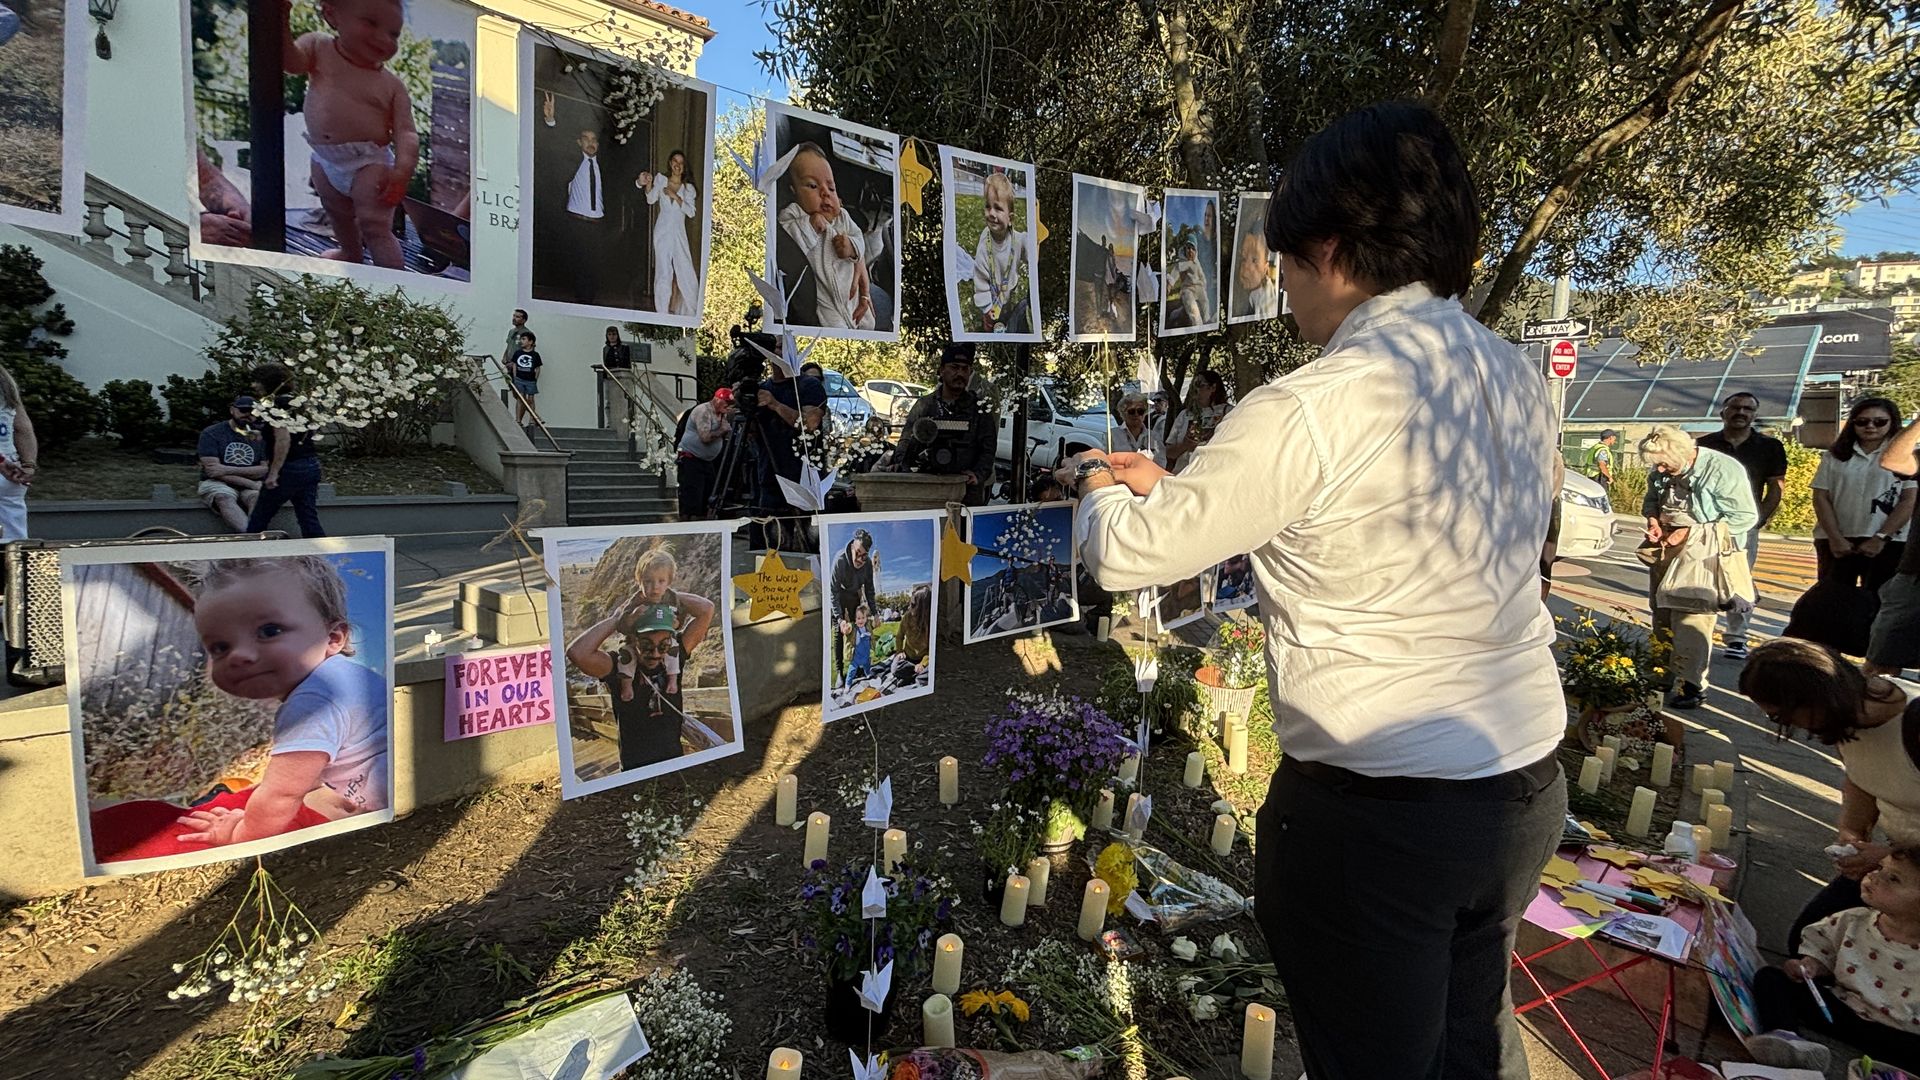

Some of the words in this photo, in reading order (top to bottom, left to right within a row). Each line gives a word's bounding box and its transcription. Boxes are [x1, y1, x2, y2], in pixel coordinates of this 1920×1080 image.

[477, 191, 514, 208] LIC
[1527, 326, 1548, 335] ONE
[1551, 325, 1569, 333] WAY
[1820, 334, 1859, 344] .com
[757, 572, 772, 582] The
[757, 594, 789, 603] without
[768, 603, 788, 612] you
[454, 650, 552, 688] FOREVER
[465, 689, 489, 709] IN
[502, 680, 543, 704] OUR
[459, 699, 550, 735] HEARTS
